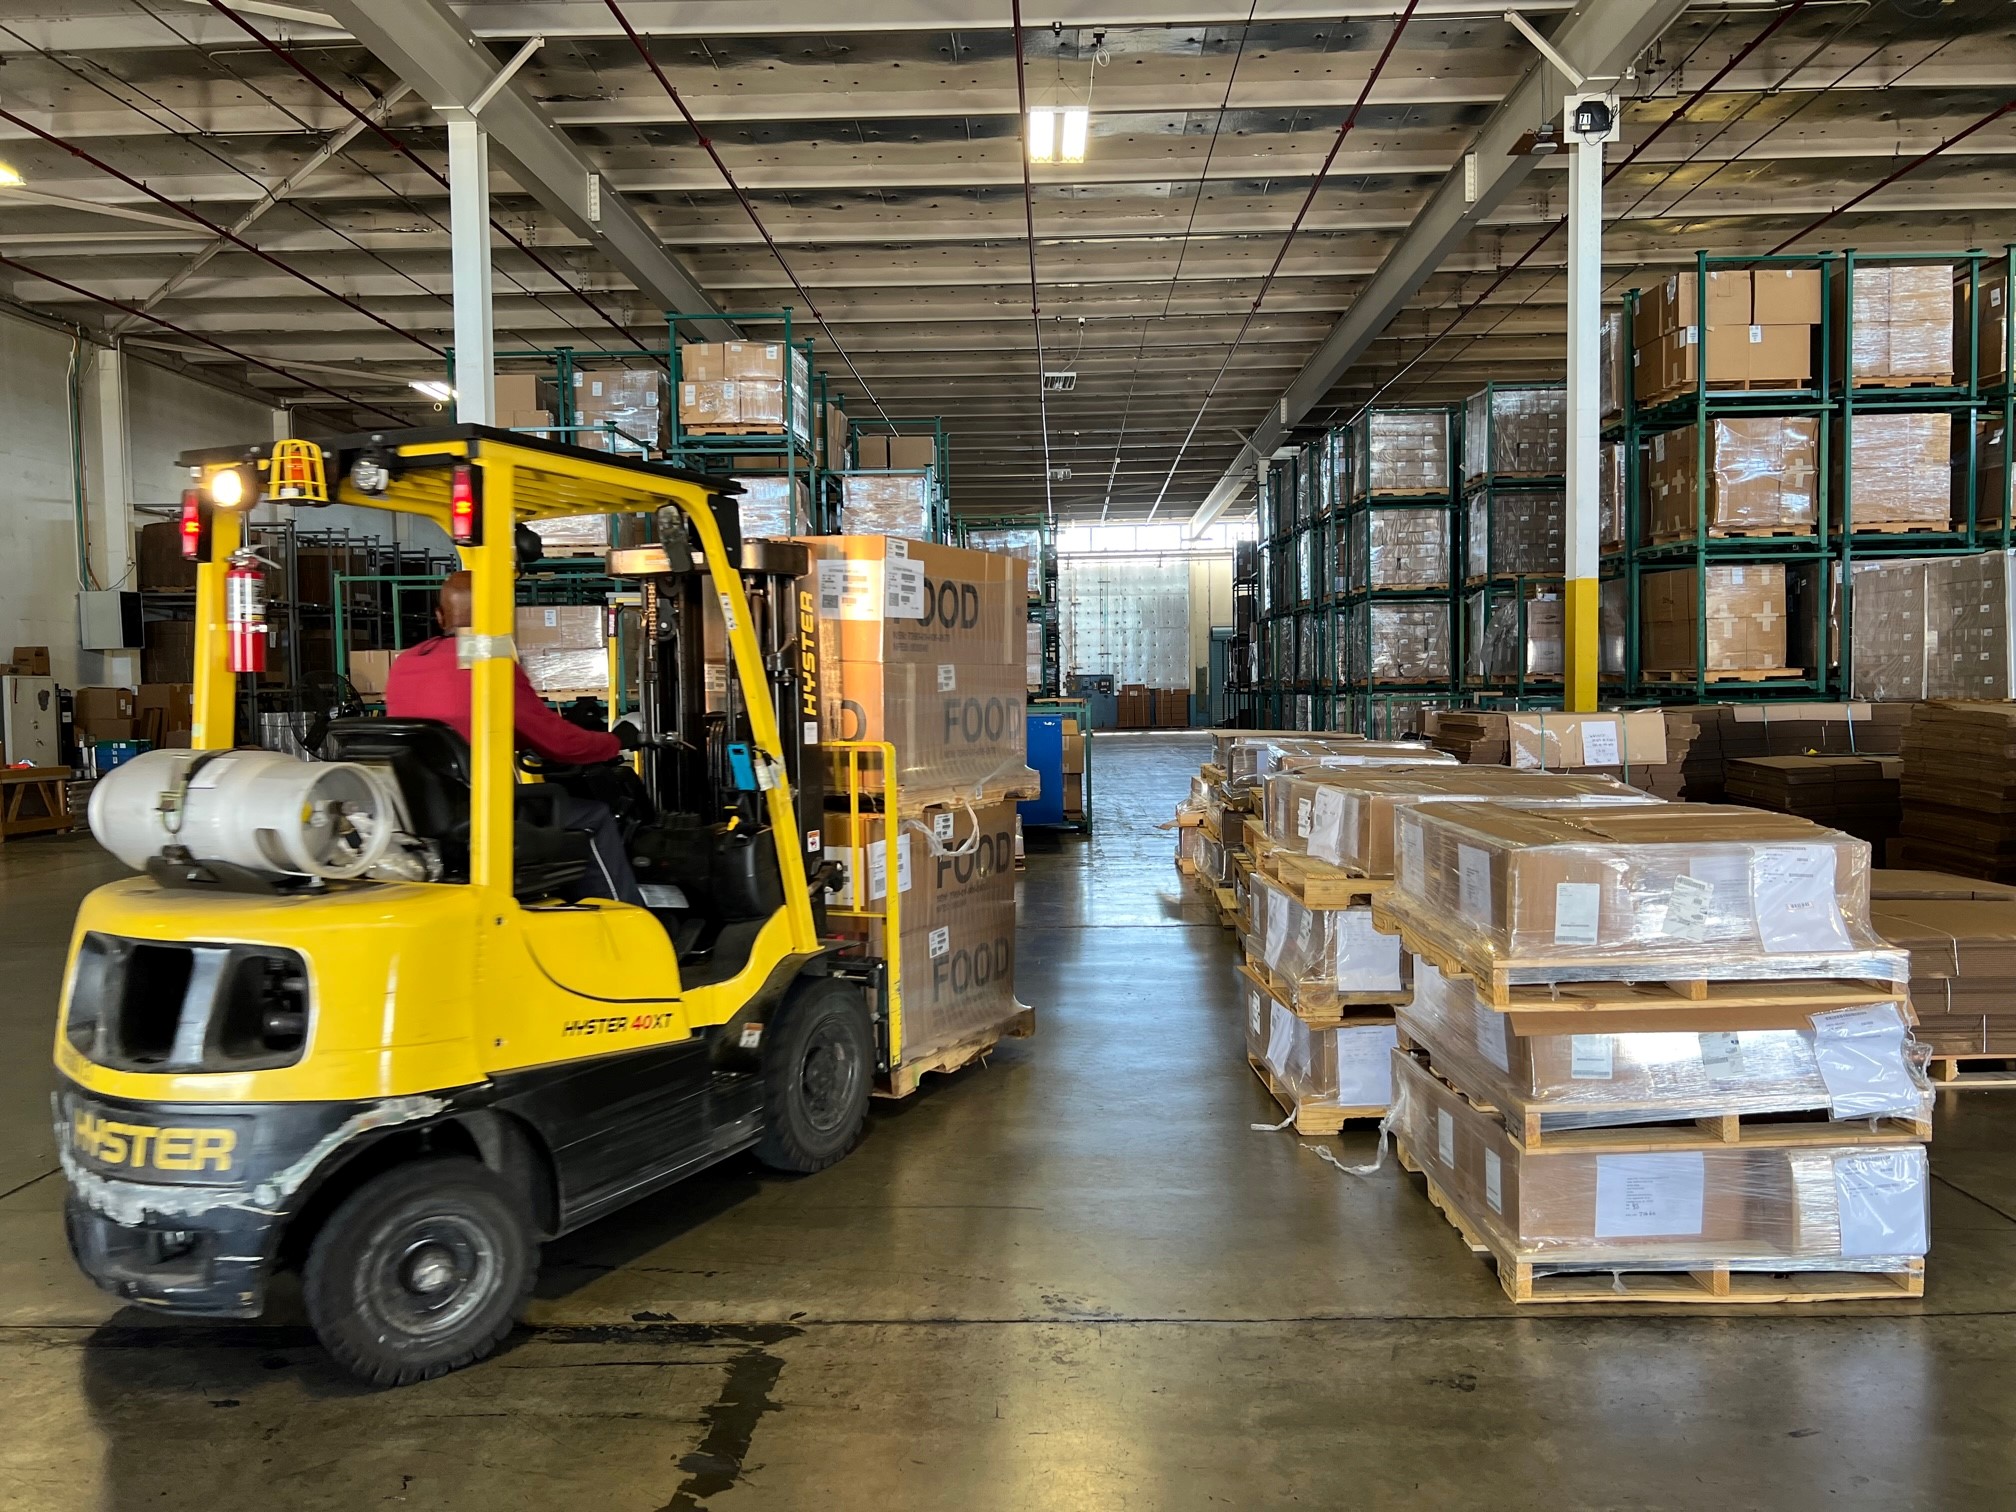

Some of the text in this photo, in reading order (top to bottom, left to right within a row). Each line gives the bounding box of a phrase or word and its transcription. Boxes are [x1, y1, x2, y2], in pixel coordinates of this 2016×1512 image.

[893, 578, 980, 629] OOD
[799, 591, 818, 716] HYSTER
[943, 696, 1022, 745] FOOD
[935, 830, 1011, 890] FOOD
[932, 935, 1010, 1004] FOOD
[561, 1016, 628, 1038] HYSTER
[73, 1107, 238, 1172] HYSTER
